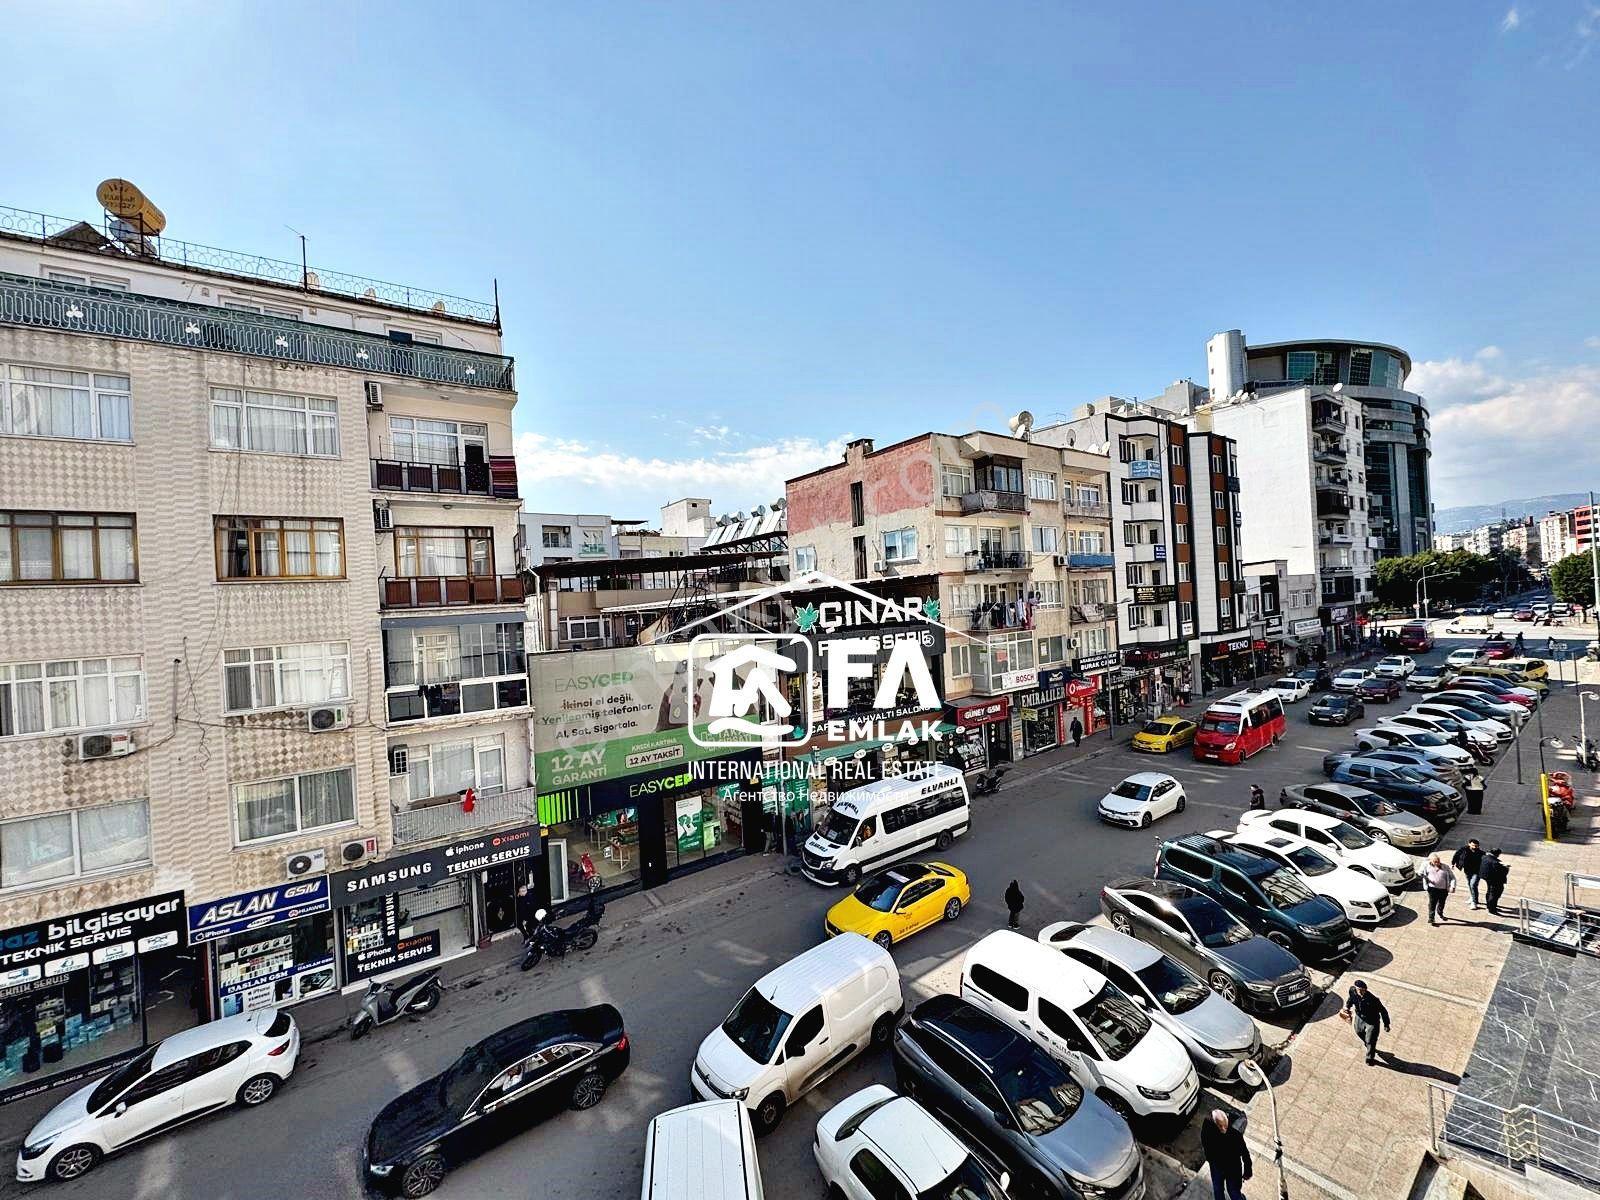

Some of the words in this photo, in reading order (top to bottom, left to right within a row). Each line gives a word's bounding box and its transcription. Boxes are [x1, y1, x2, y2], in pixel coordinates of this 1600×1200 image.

[818, 597, 923, 633] ÇINAR
[1016, 674, 1034, 683] BOSCH
[551, 755, 575, 772] 12
[578, 748, 607, 768] AY
[630, 757, 641, 766] 12
[641, 753, 652, 764] AY
[653, 745, 681, 761] TAKSİT
[552, 764, 607, 786] GARANTİ
[629, 774, 694, 798] EASYCEP
[921, 777, 959, 795] ELVANLI
[447, 855, 488, 874] TEKNIK
[491, 846, 530, 863] SERVIS
[455, 841, 485, 855] iphone
[347, 862, 432, 892] SAMSUNG
[197, 891, 279, 927] ASLAN
[284, 880, 321, 899] GSM
[48, 898, 180, 940] bilgisayar
[357, 955, 396, 973] TEKNIK
[397, 944, 433, 961] SERVIS
[367, 947, 392, 959] iPhone
